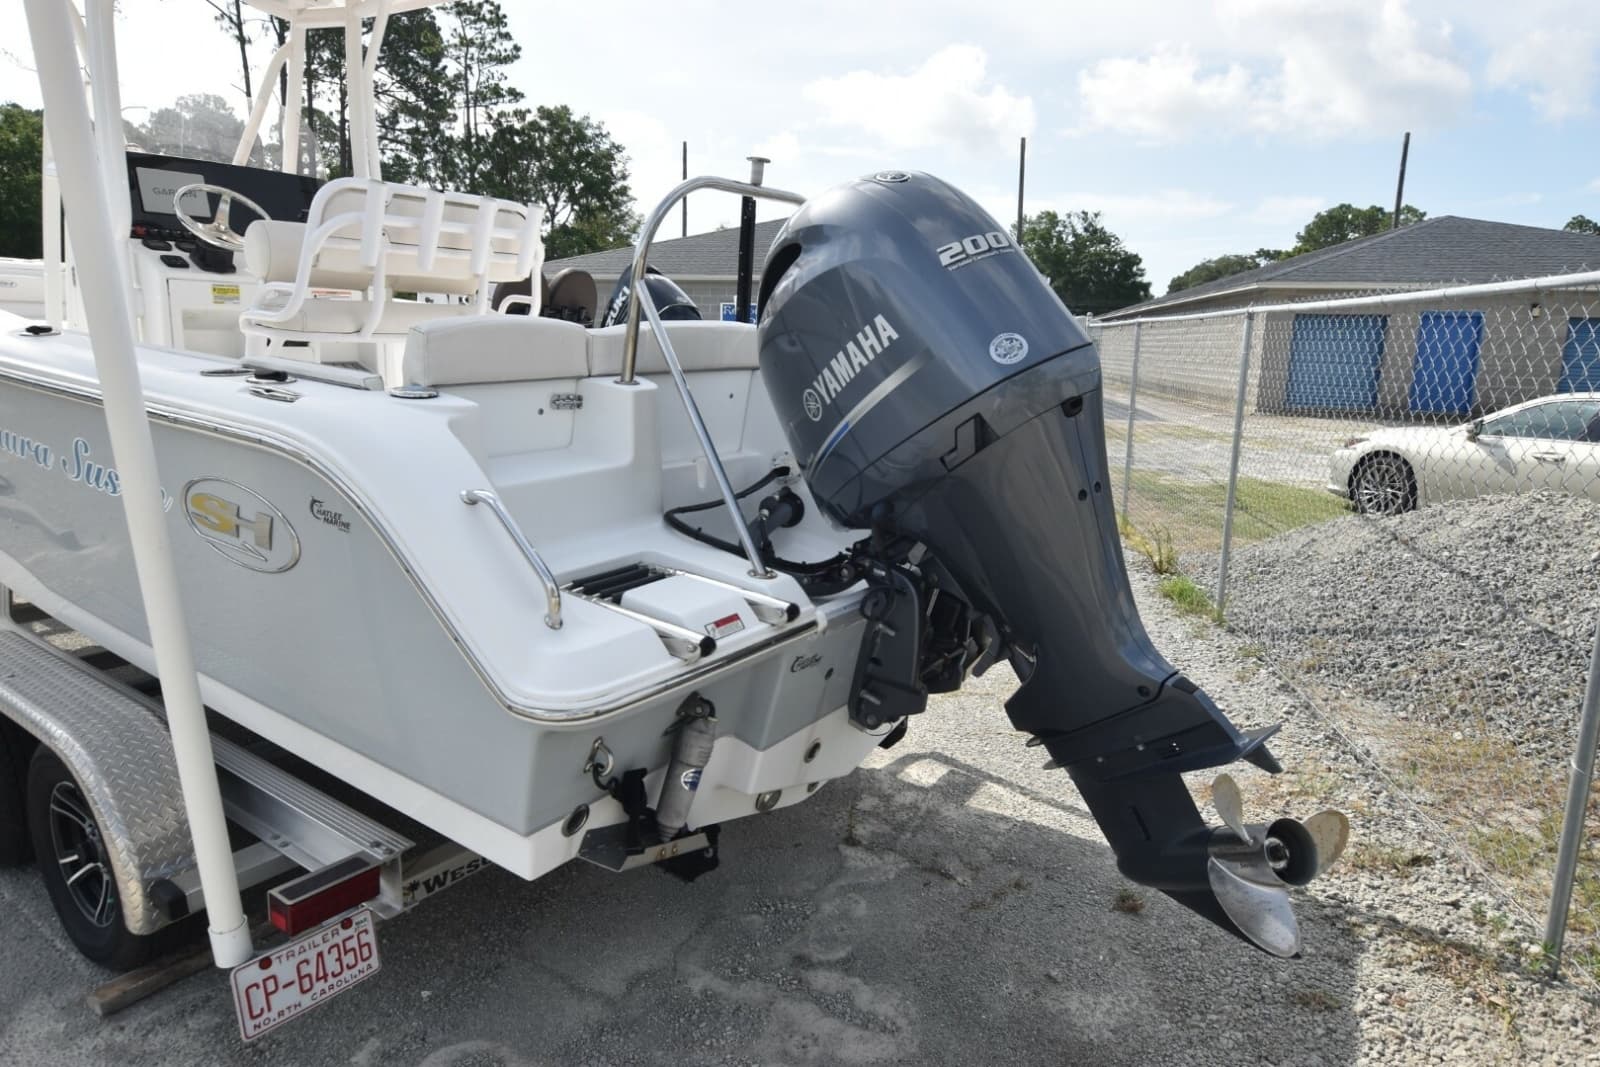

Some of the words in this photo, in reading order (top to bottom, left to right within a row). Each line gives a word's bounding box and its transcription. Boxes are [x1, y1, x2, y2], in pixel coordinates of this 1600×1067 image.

[936, 231, 1010, 267] 200
[604, 285, 631, 327] ZUKI
[812, 313, 900, 405] YAMAHA
[0, 429, 53, 470] ura
[275, 928, 340, 964] TRAILER
[244, 928, 373, 1021] CP-64356
